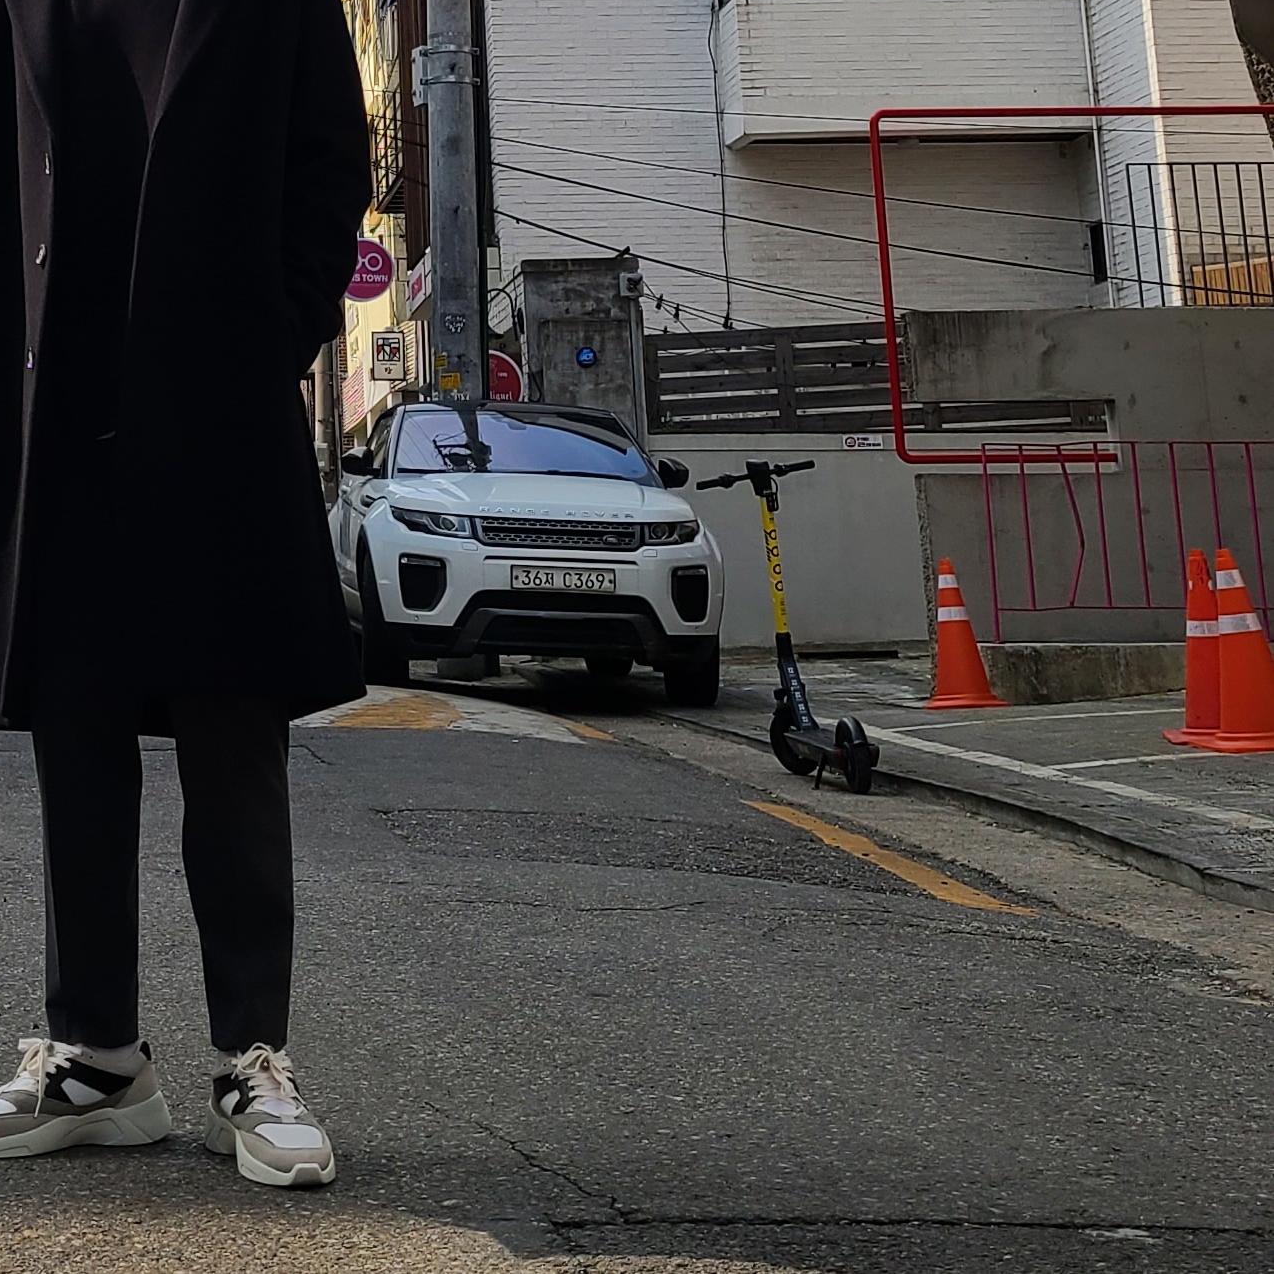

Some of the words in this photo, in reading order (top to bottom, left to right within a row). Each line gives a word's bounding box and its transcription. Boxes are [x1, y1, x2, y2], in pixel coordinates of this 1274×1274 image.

[362, 274, 389, 283] TOWN
[478, 505, 550, 516] RANGE
[565, 509, 635, 519] ROVER
